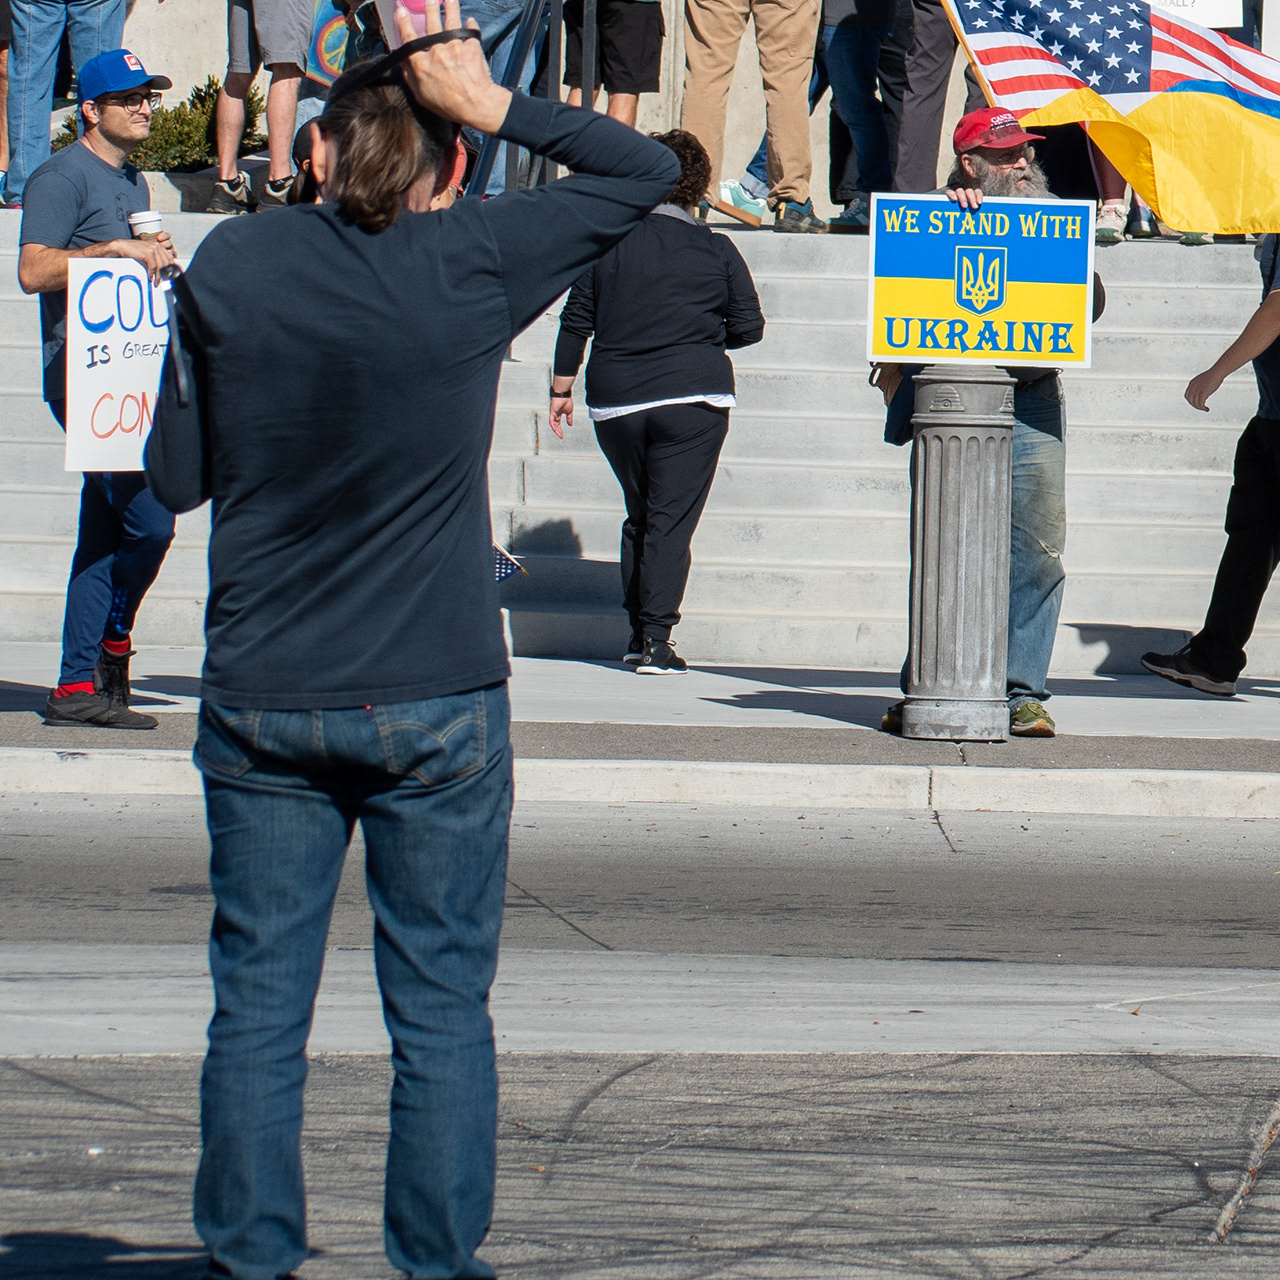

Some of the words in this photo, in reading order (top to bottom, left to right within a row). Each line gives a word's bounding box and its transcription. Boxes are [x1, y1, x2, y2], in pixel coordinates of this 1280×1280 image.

[883, 205, 920, 232] WE
[928, 210, 1010, 235] STAND
[1019, 211, 1082, 238] WITH
[883, 317, 1076, 353] UKRAINE
[87, 344, 112, 369] IS
[123, 341, 167, 360] GREAT
